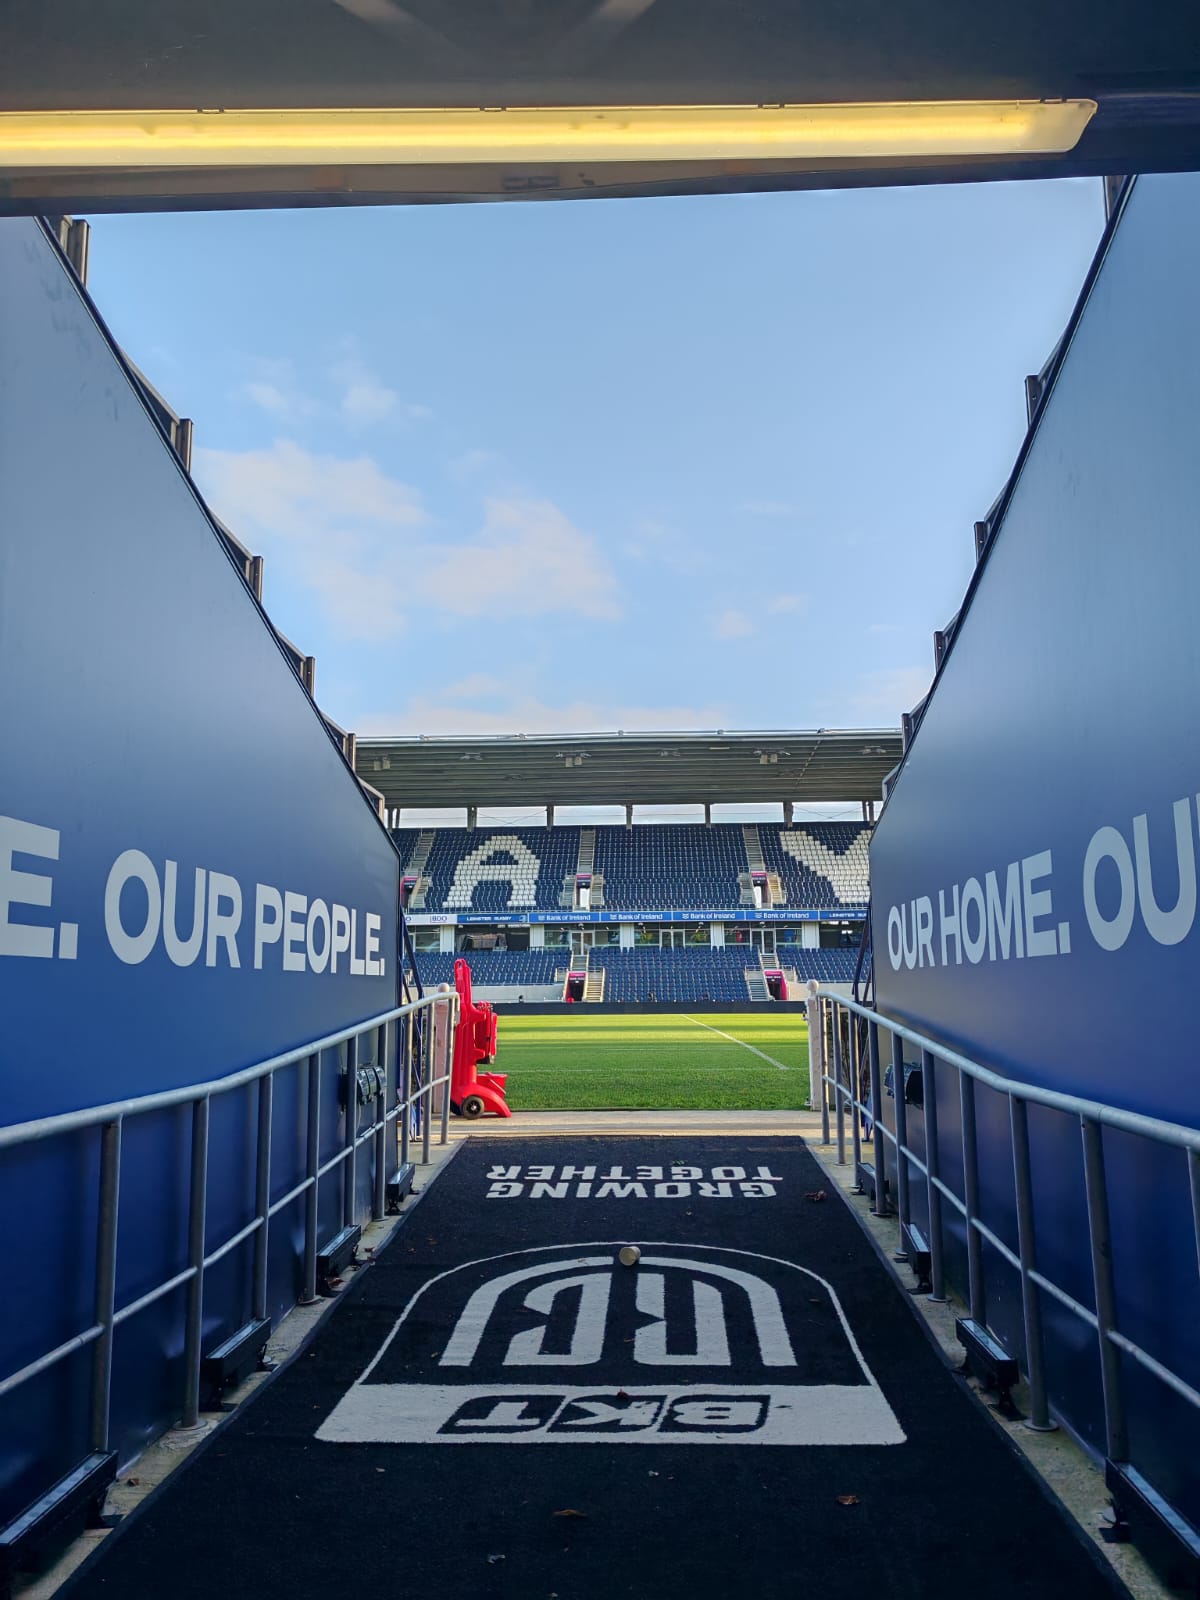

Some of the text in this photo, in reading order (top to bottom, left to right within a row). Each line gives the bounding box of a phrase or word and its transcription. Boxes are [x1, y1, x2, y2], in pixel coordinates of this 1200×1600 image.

[887, 792, 1200, 972] OUR HOME. OU
[104, 848, 243, 970] OUR
[254, 882, 386, 977] PEOPLE.
[486, 1165, 784, 1181] TOGETHER
[485, 1182, 777, 1199] GROWING
[451, 1399, 765, 1428] BKT
